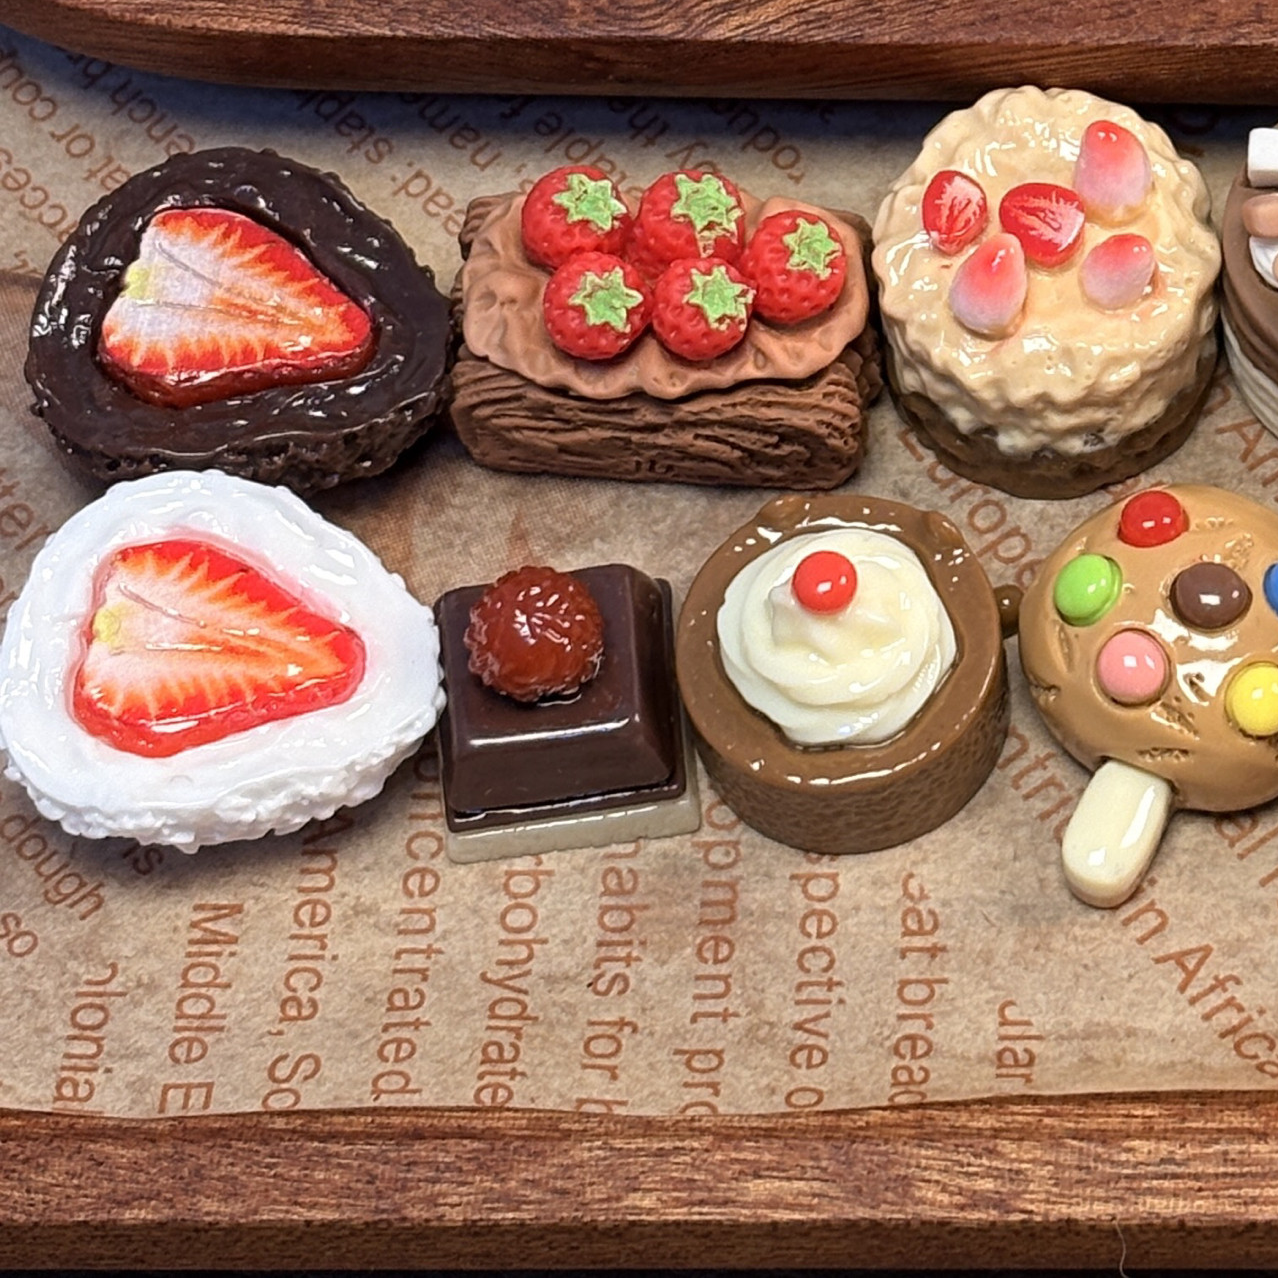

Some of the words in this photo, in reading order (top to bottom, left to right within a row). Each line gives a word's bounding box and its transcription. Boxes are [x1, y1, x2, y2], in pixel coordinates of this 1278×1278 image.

[50, 123, 96, 159] or
[167, 901, 245, 1065] Middle
[579, 1015, 639, 1082] for
